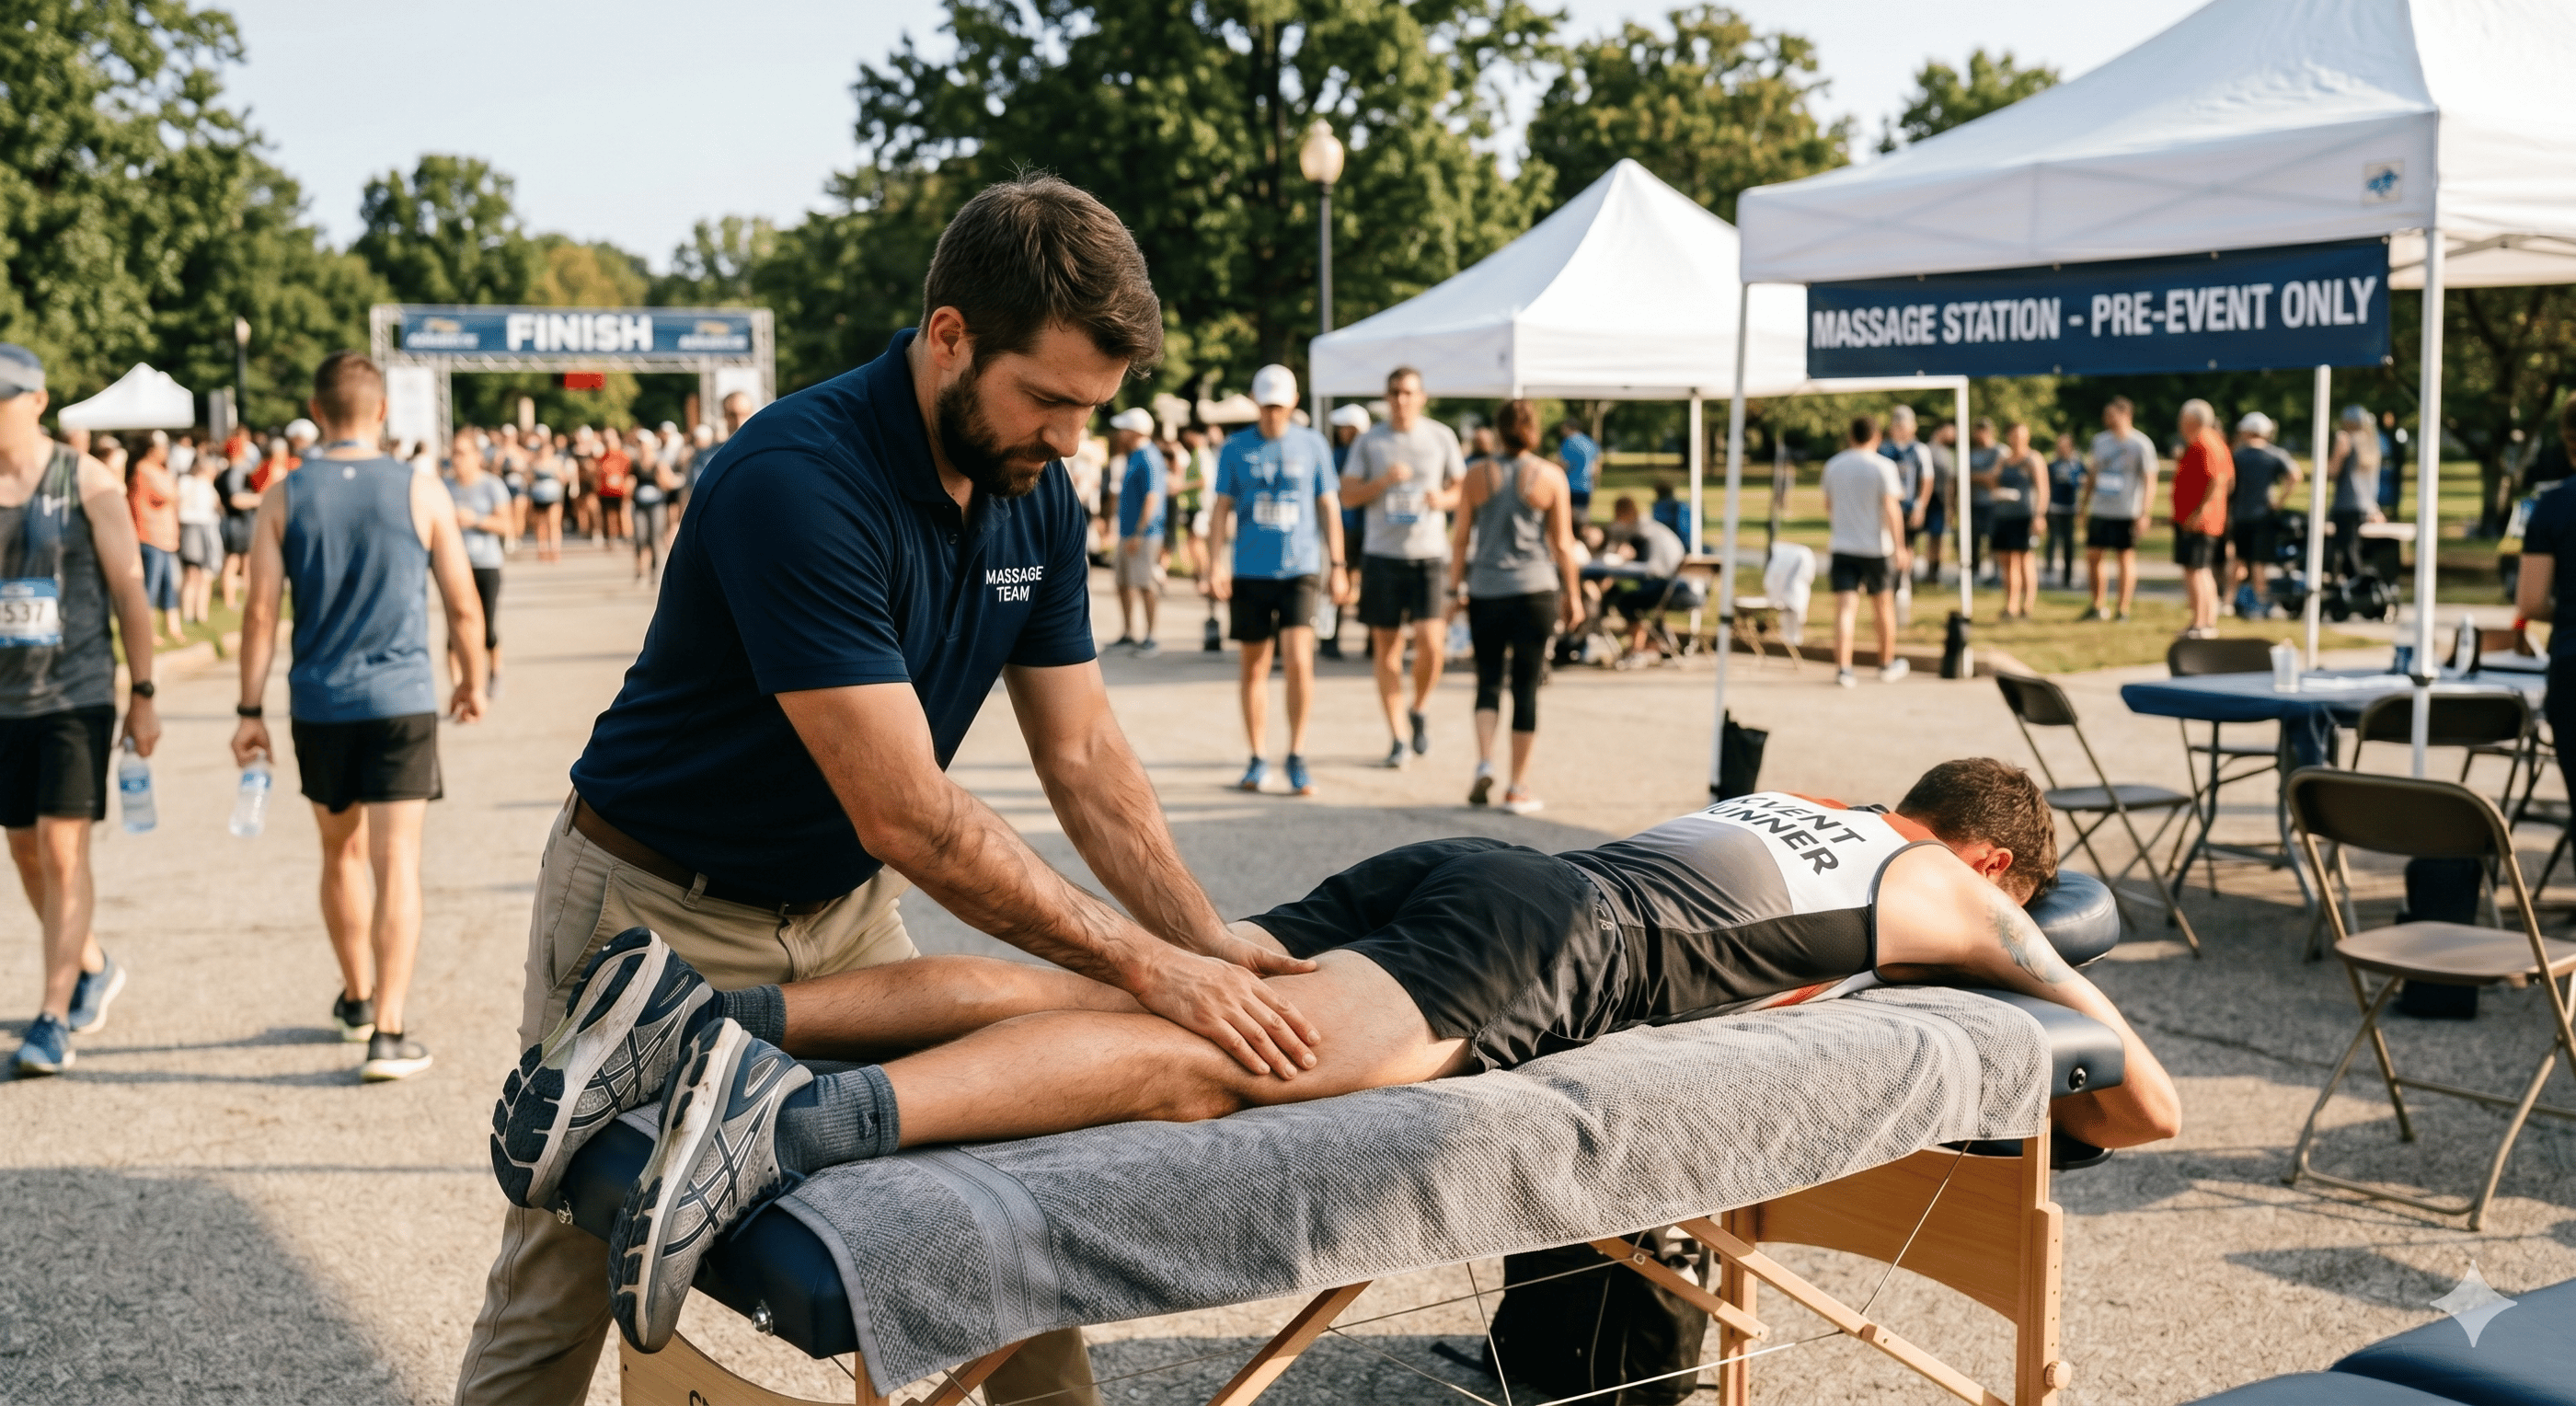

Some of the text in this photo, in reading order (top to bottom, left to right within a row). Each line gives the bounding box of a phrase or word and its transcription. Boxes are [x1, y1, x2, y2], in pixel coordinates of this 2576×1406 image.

[1812, 276, 2378, 349] MASSAGE STATION - PRE-EVENT ONLY
[506, 314, 653, 352] FINISH
[985, 565, 1044, 584] MASSAGE
[996, 585, 1030, 603] TEAM
